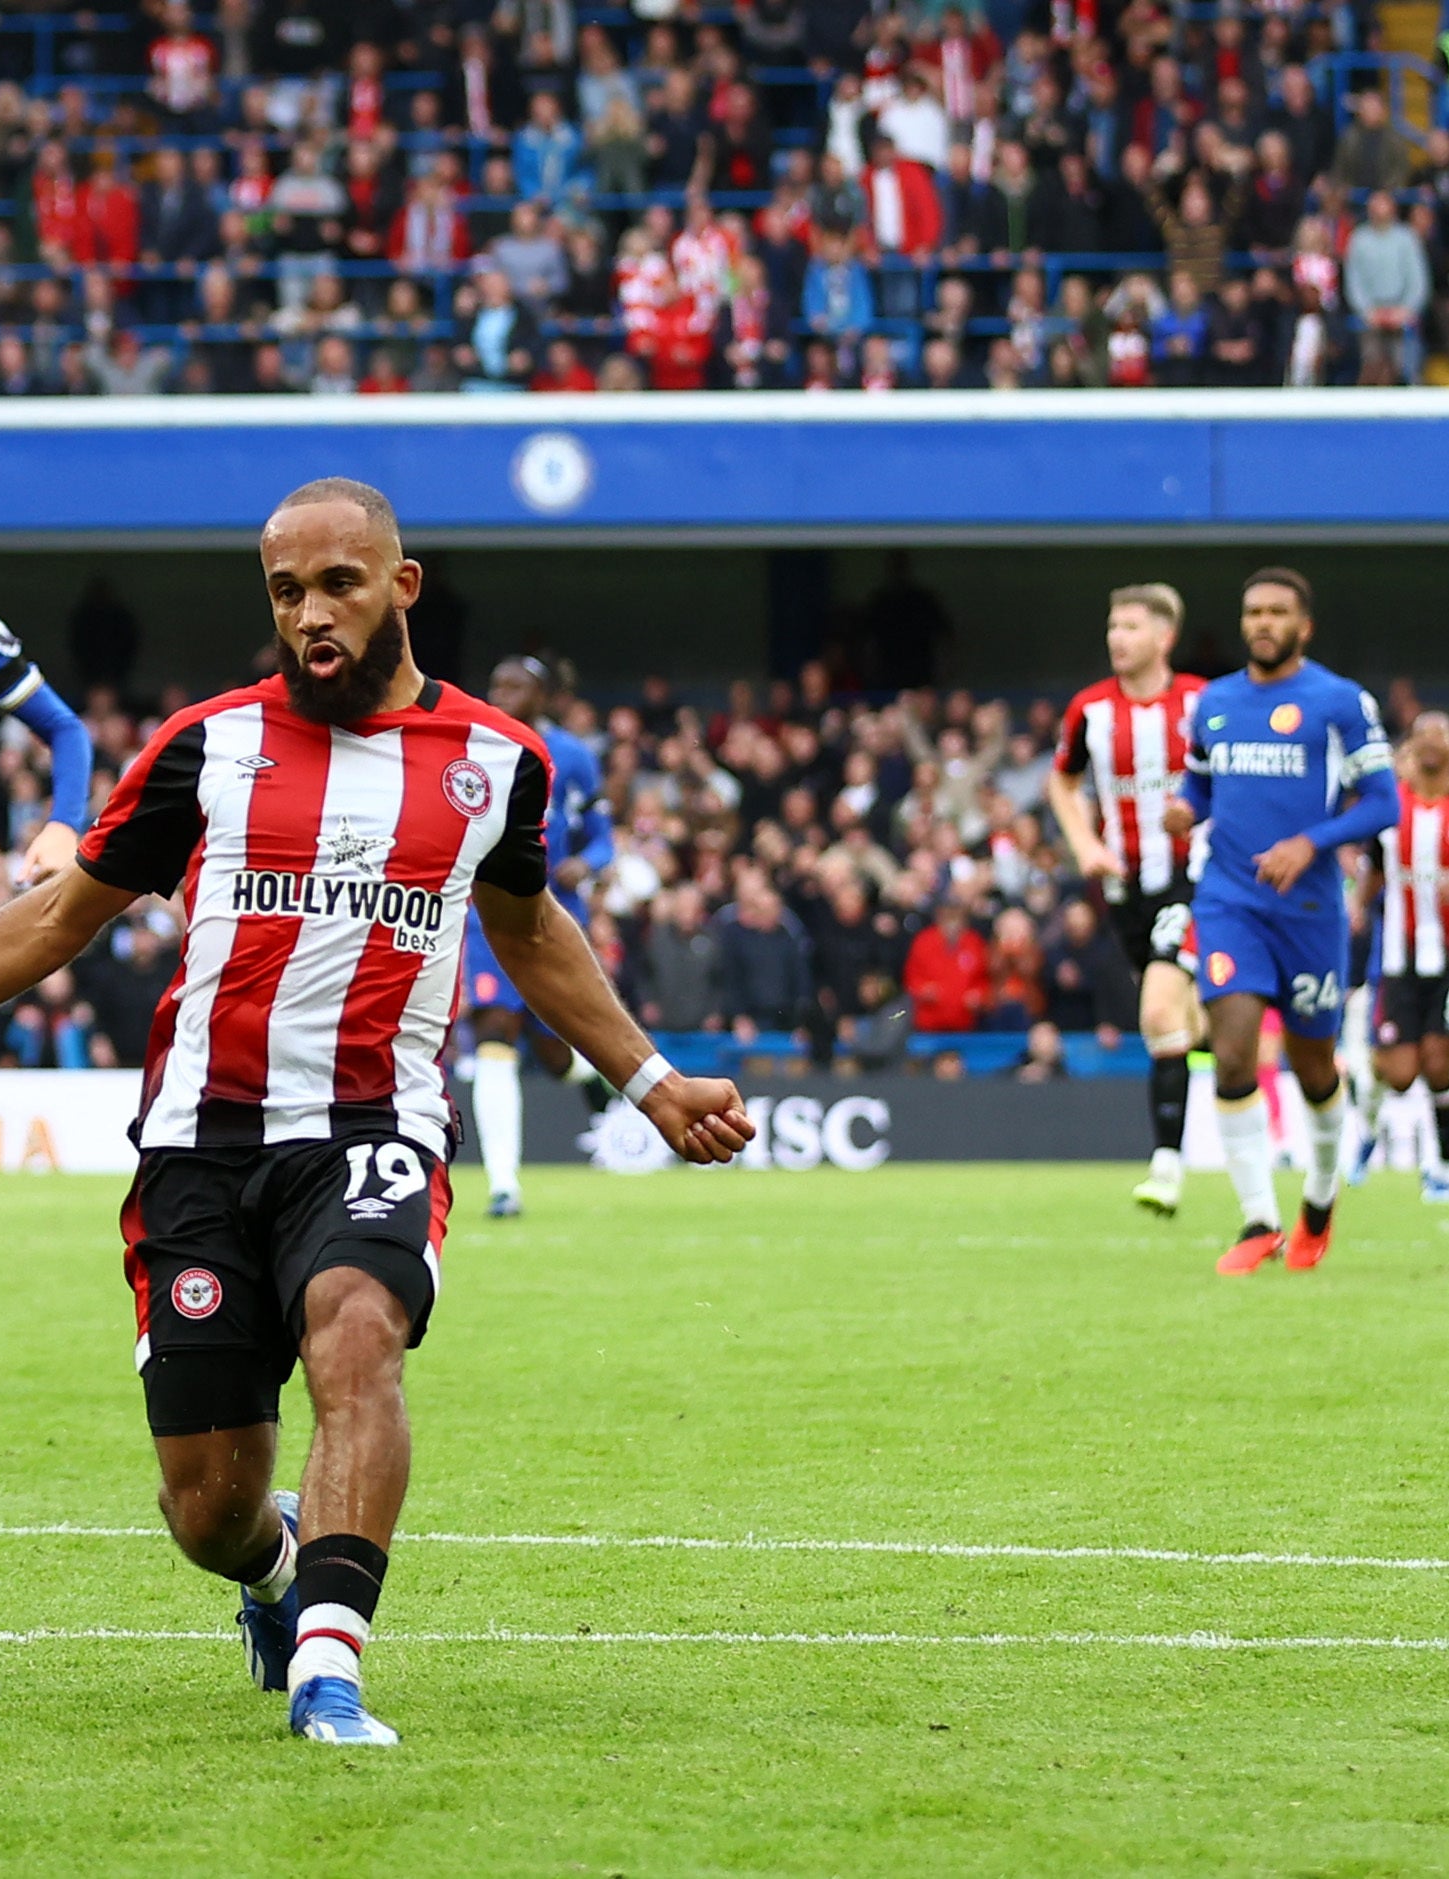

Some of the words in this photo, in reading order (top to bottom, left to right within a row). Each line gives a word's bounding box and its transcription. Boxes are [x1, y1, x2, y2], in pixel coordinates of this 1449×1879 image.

[232, 872, 444, 932] HOLLYWOOD
[396, 926, 437, 952] bets
[1291, 970, 1341, 1016] 24
[343, 1142, 427, 1202] 19
[351, 1211, 388, 1221] umbro
